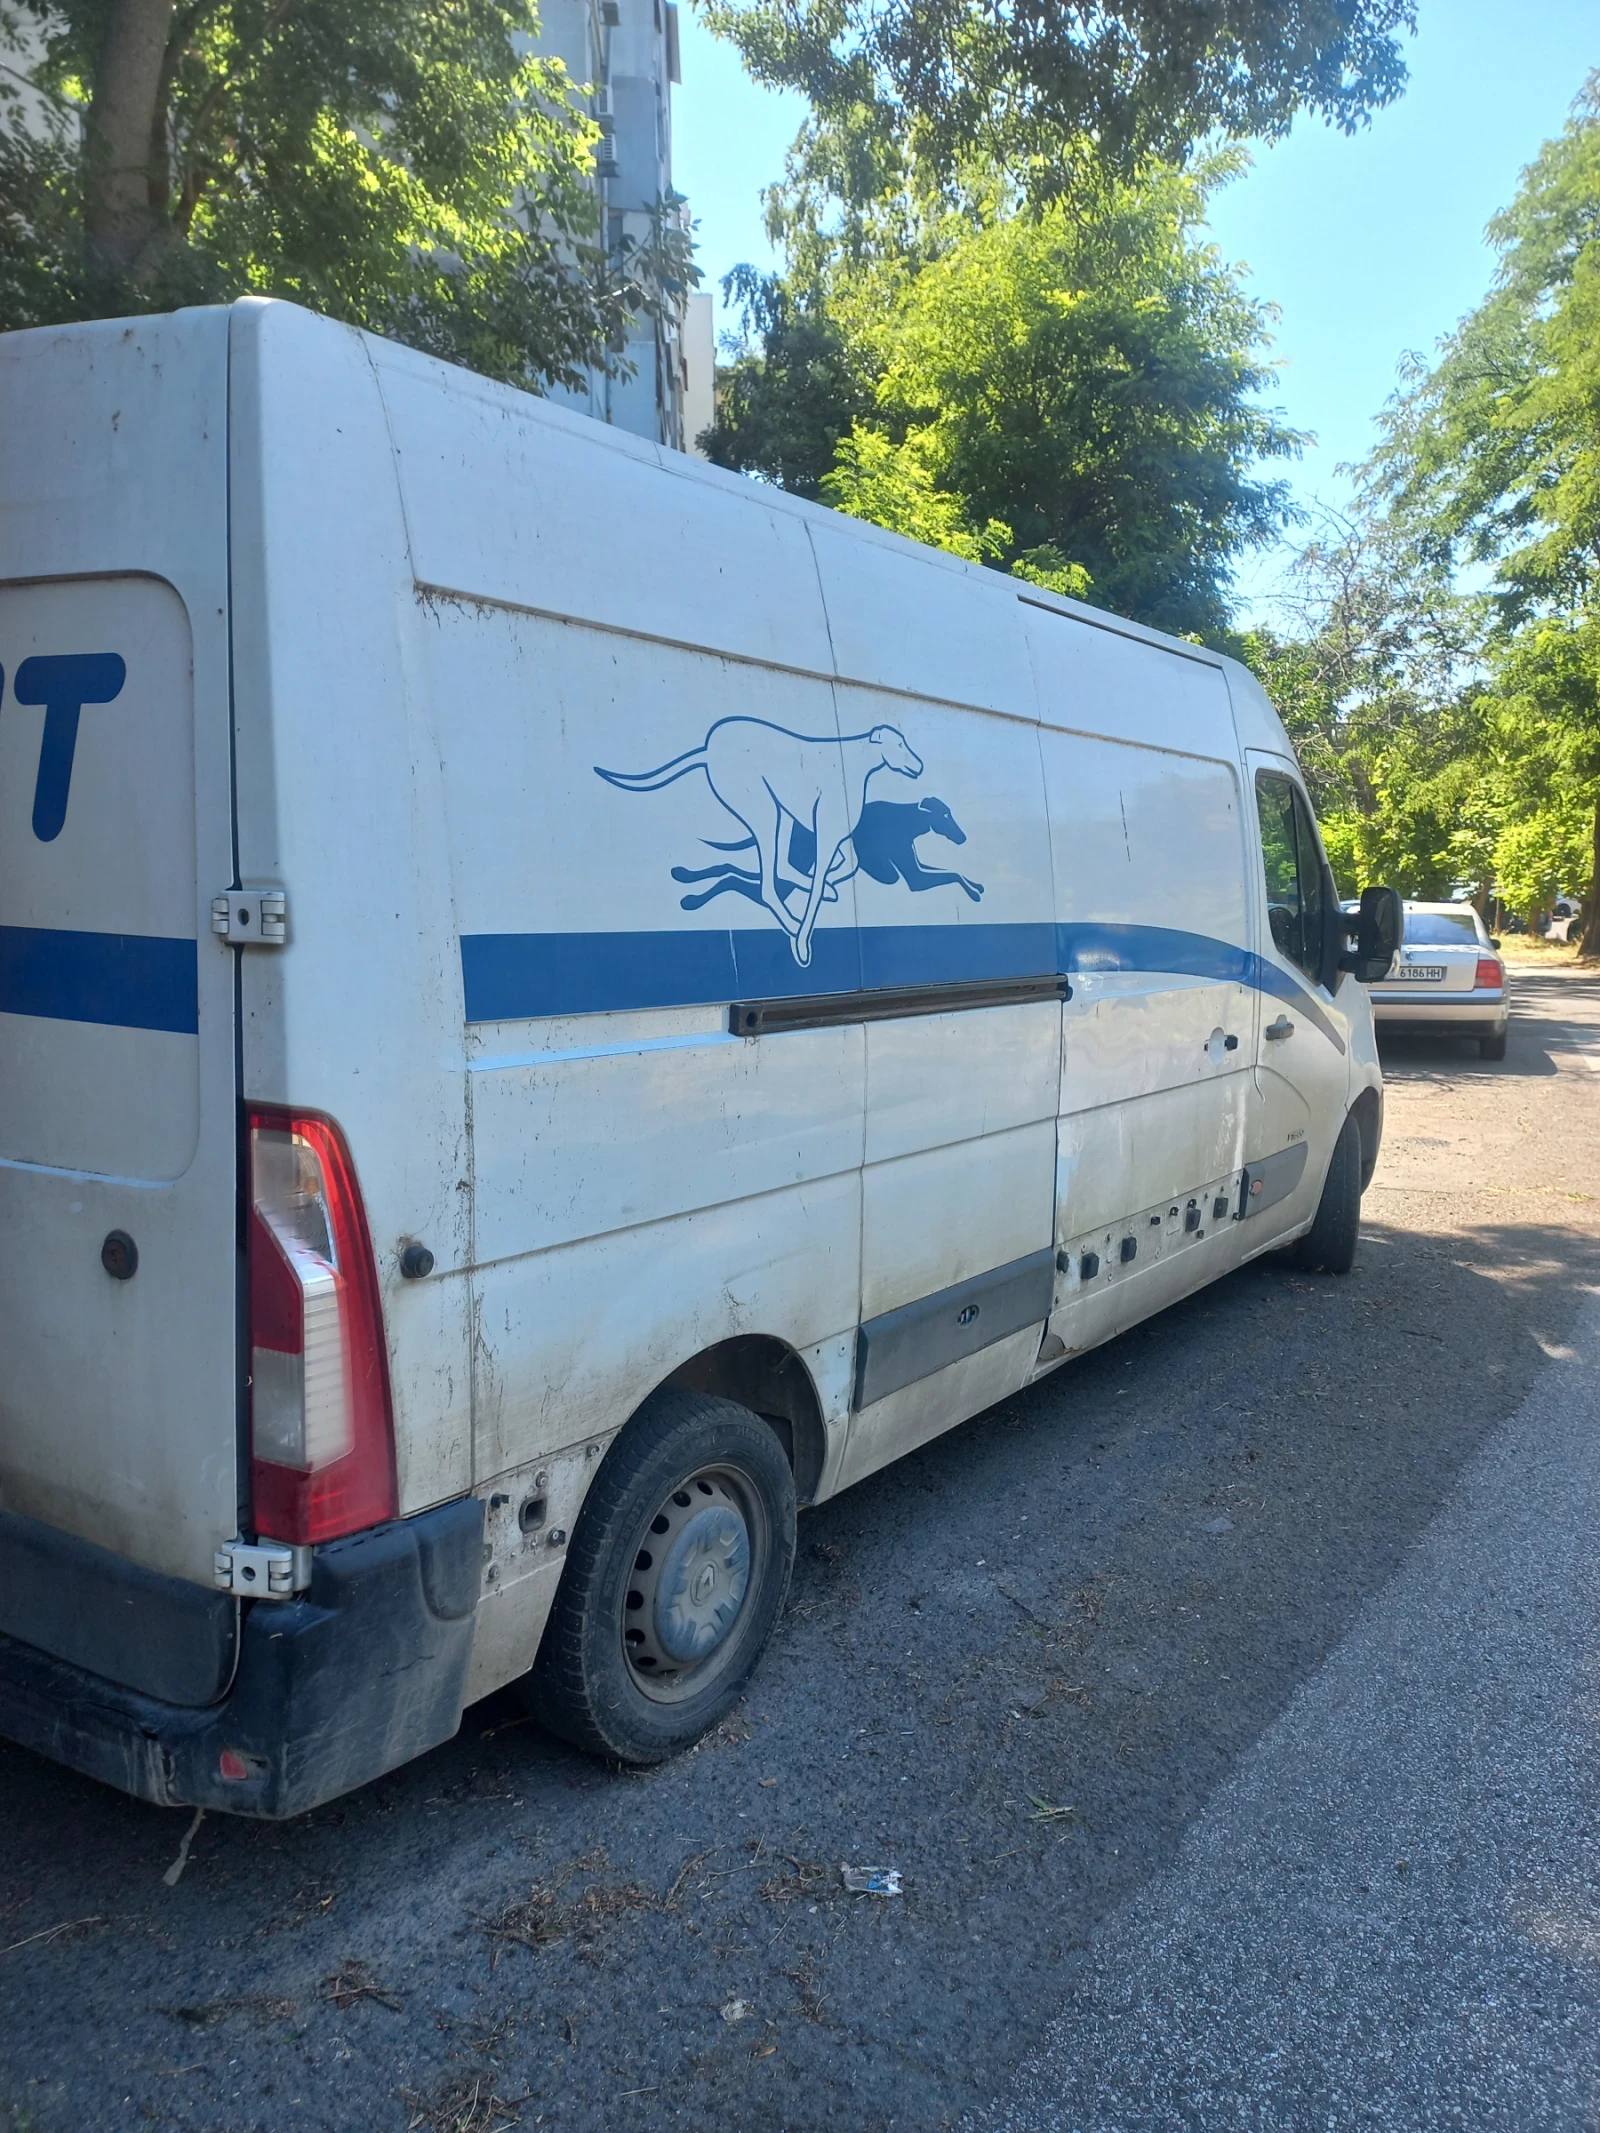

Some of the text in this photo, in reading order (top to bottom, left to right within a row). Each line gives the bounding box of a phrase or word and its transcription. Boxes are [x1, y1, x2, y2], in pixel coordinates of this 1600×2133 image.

[0, 652, 126, 842] T
[1400, 968, 1425, 978] 6186
[1426, 968, 1440, 978] HH
